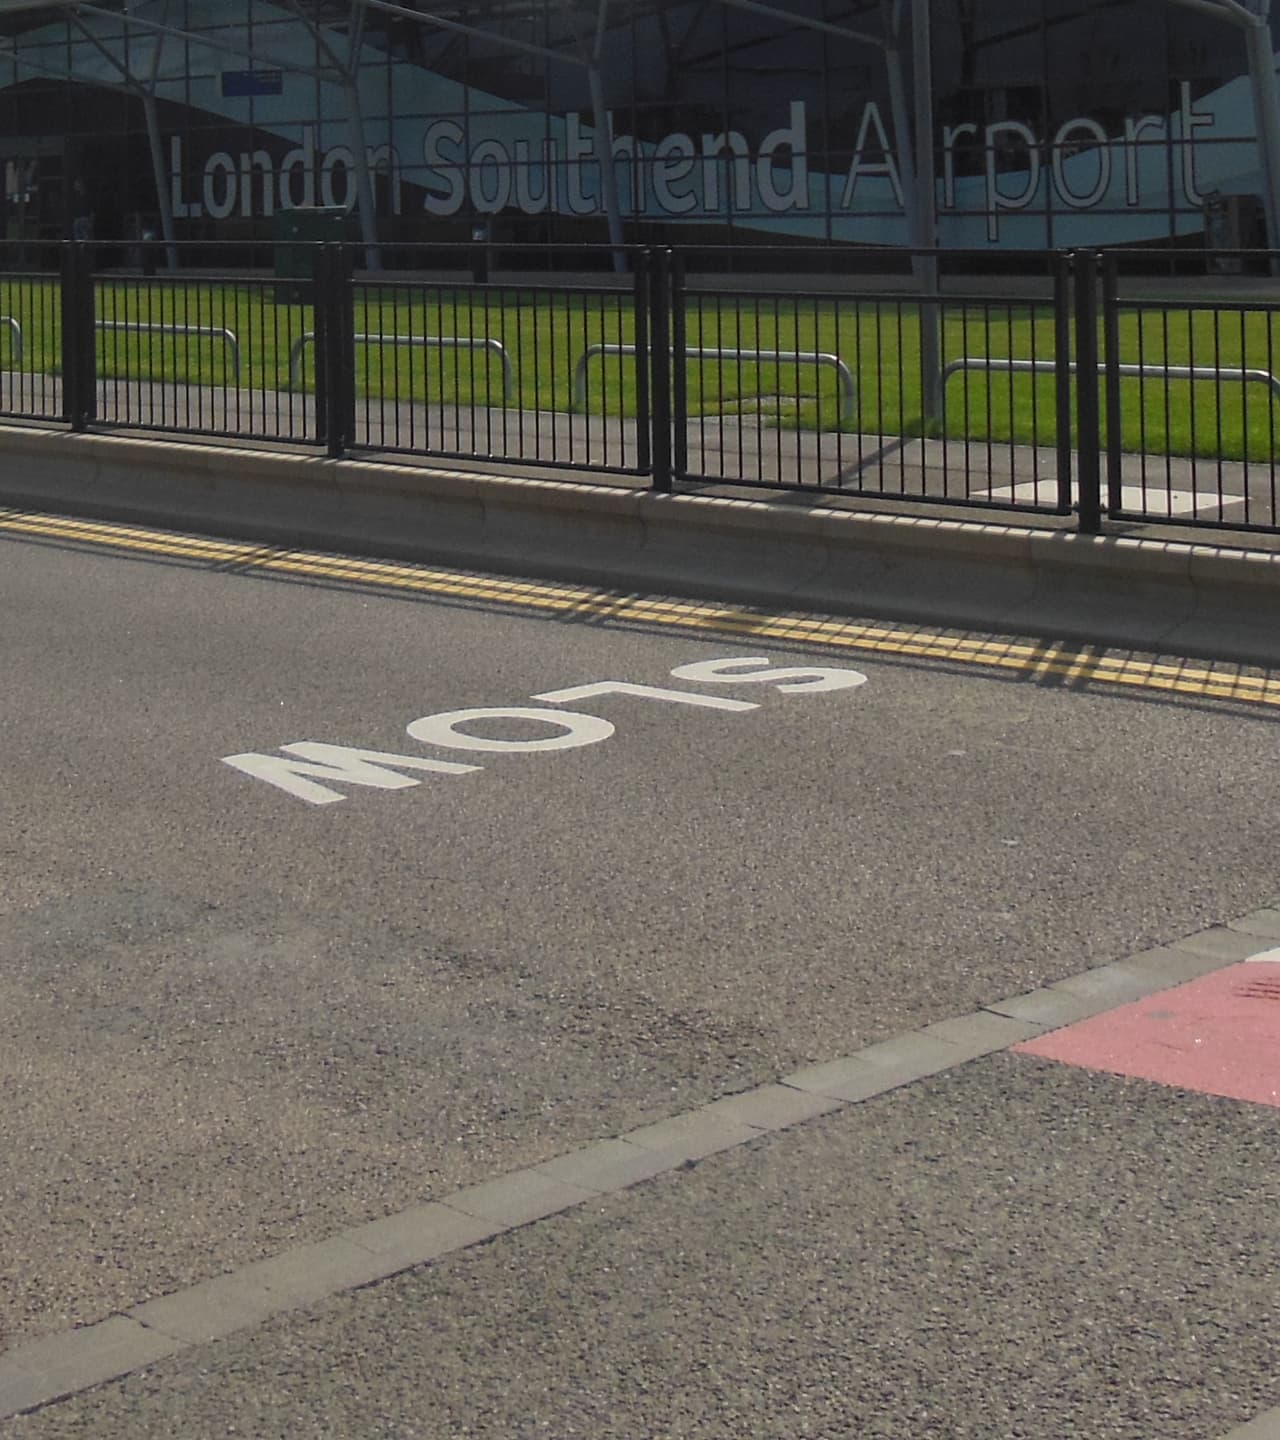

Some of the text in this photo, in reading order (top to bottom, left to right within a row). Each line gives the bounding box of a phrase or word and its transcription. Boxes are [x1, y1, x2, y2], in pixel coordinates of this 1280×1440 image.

[171, 81, 1217, 242] London Southend Arport
[221, 656, 868, 804] SLOW
